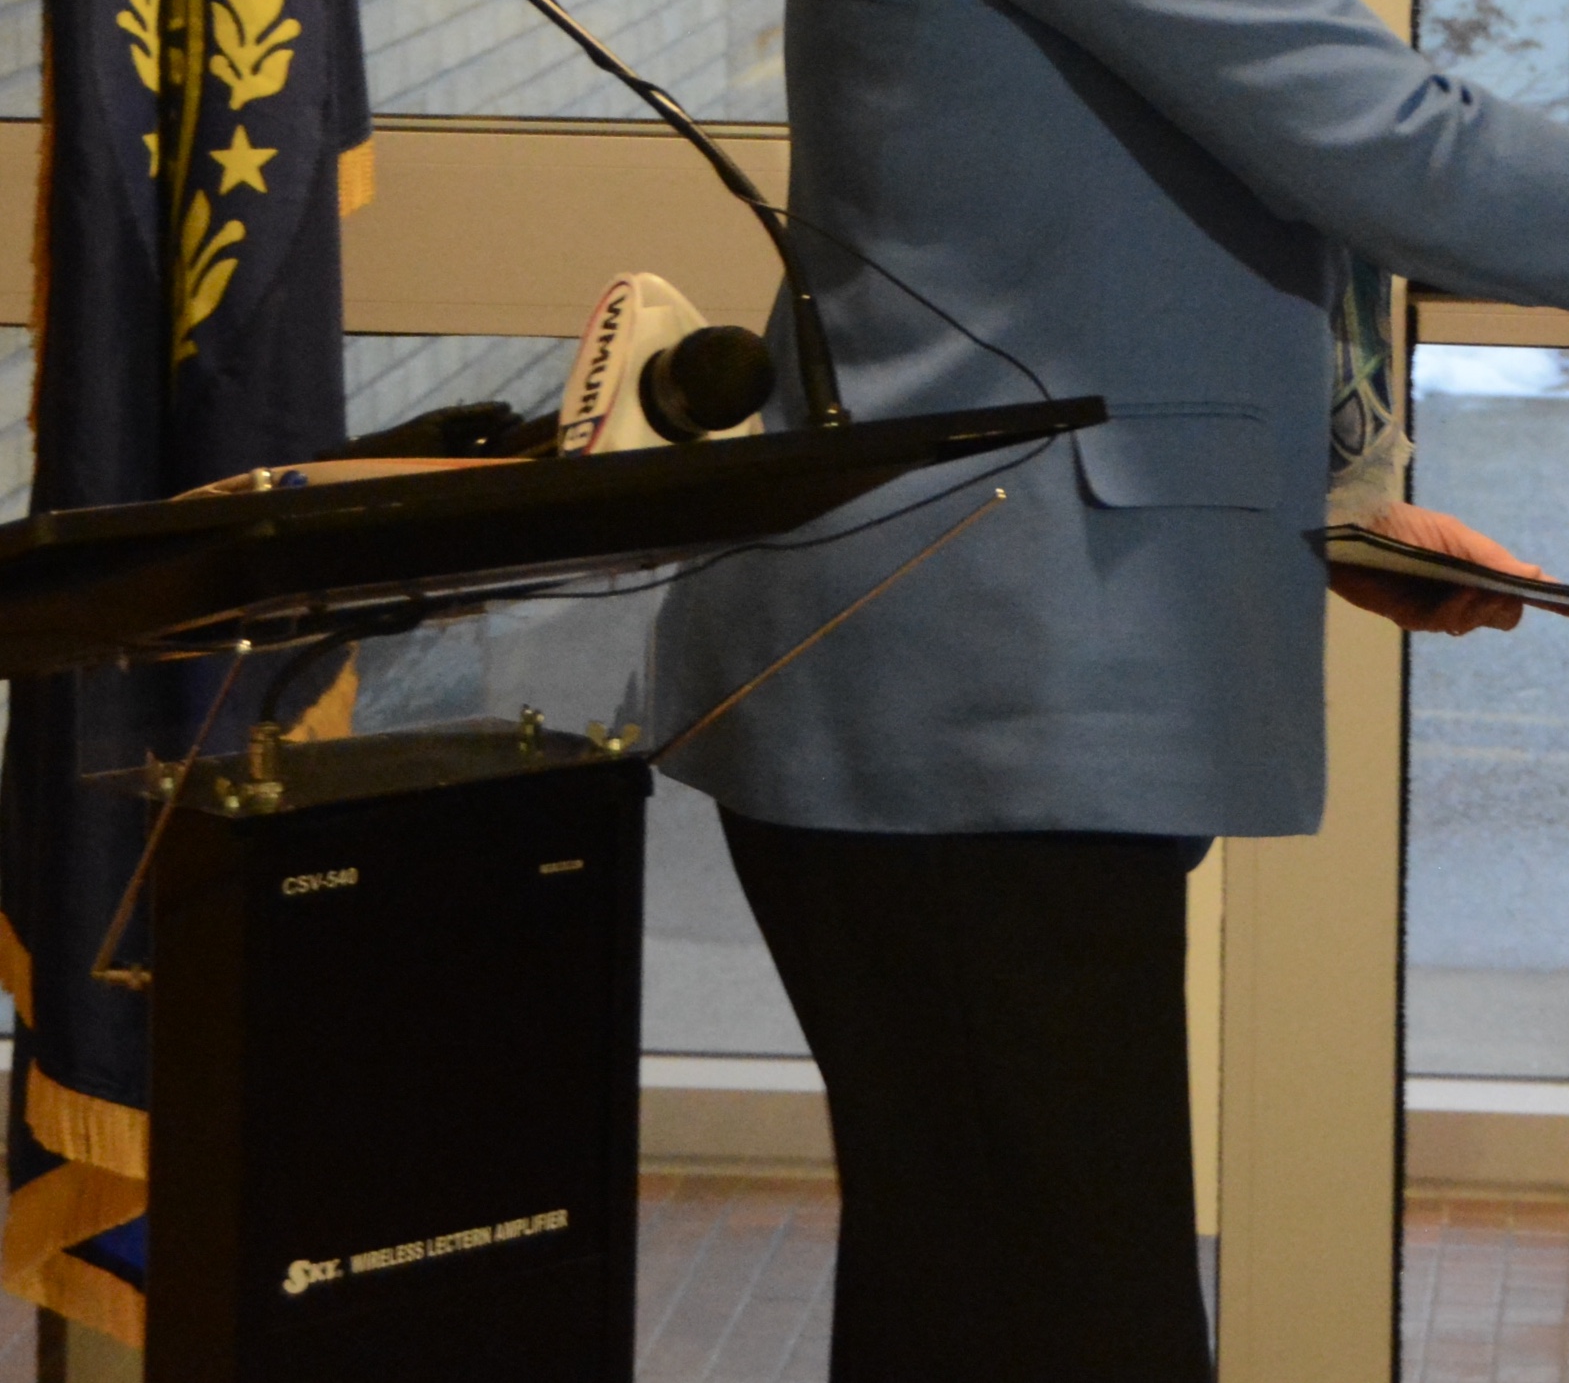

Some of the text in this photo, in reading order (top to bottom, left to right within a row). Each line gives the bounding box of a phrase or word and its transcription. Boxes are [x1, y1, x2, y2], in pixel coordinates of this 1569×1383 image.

[577, 295, 627, 415] WMUR
[350, 1241, 425, 1273] WIRELESS
[427, 1225, 492, 1257] LECTERN
[494, 1209, 568, 1242] AMPLIFIER
